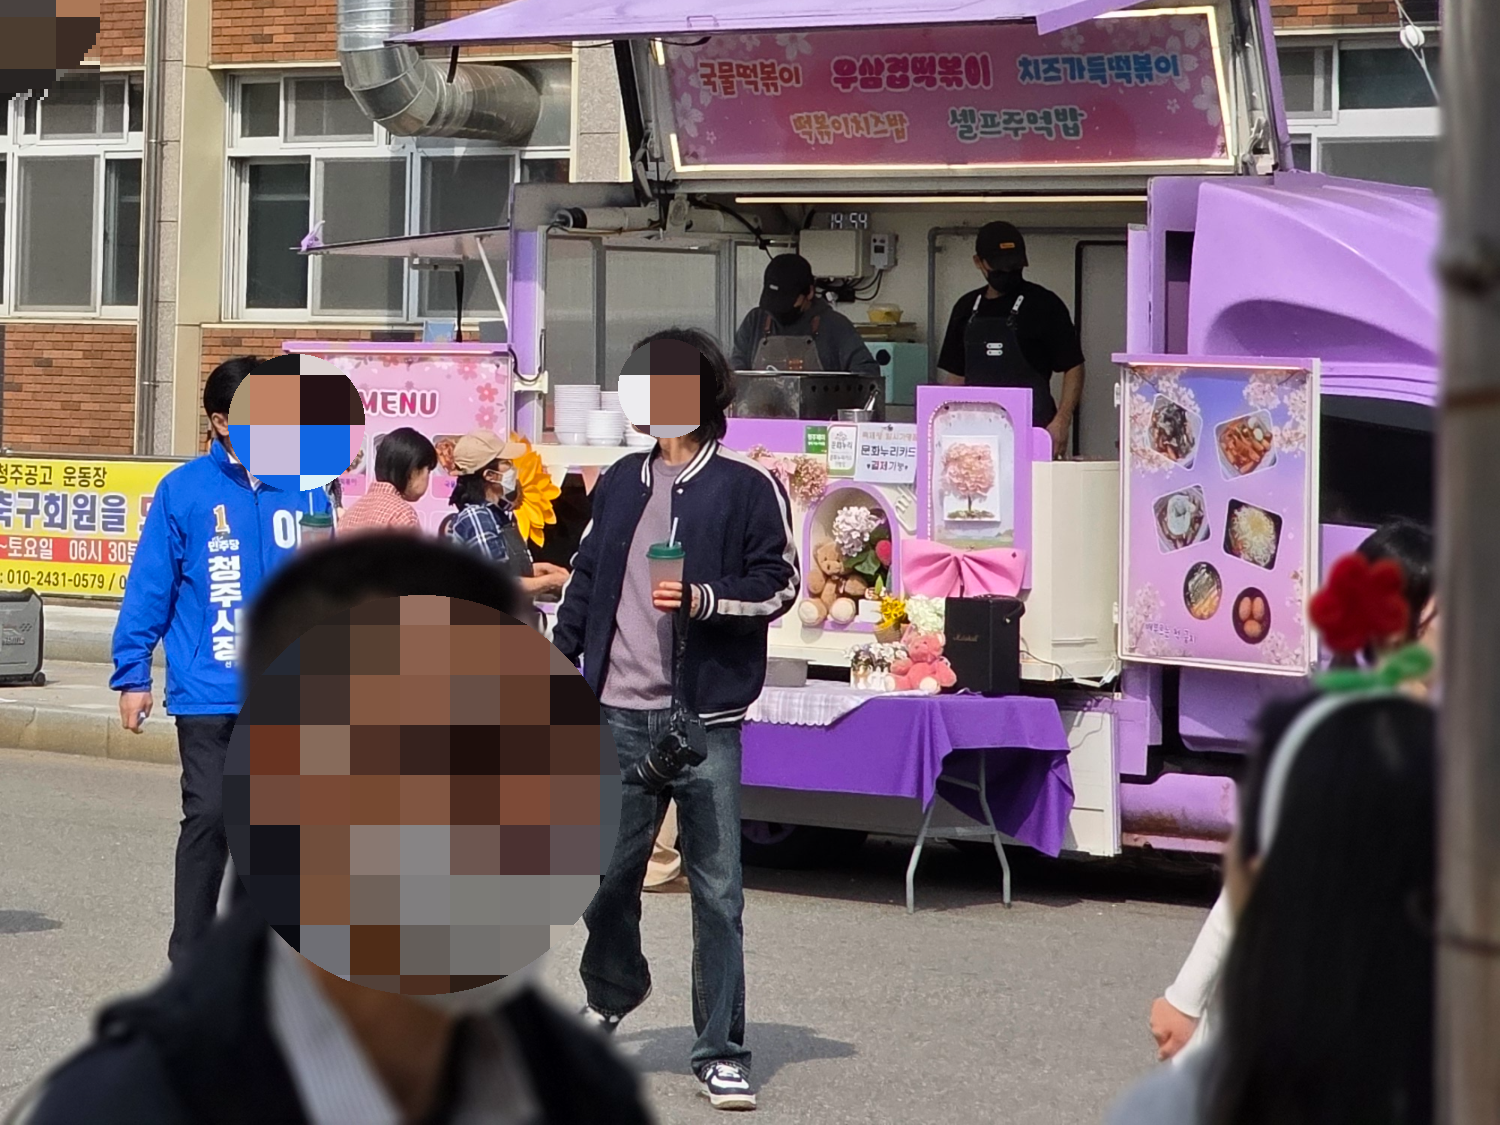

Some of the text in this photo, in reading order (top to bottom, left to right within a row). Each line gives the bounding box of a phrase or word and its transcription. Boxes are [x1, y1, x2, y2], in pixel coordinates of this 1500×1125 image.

[699, 54, 1181, 97] 국물떡볶이 우삼겹떡볶이 치즈가득떡볶이
[791, 106, 1086, 143] 떡볶이치즈밥 셀프주먹밥
[359, 390, 437, 416] MENU
[861, 444, 916, 458] 문화누리카드
[63, 465, 108, 488] 운동장
[213, 504, 230, 535] 1
[68, 539, 103, 563] 06시
[208, 539, 240, 553] 민주당
[7, 569, 105, 589] 010-2431-0579
[208, 555, 242, 662] 청주시장
